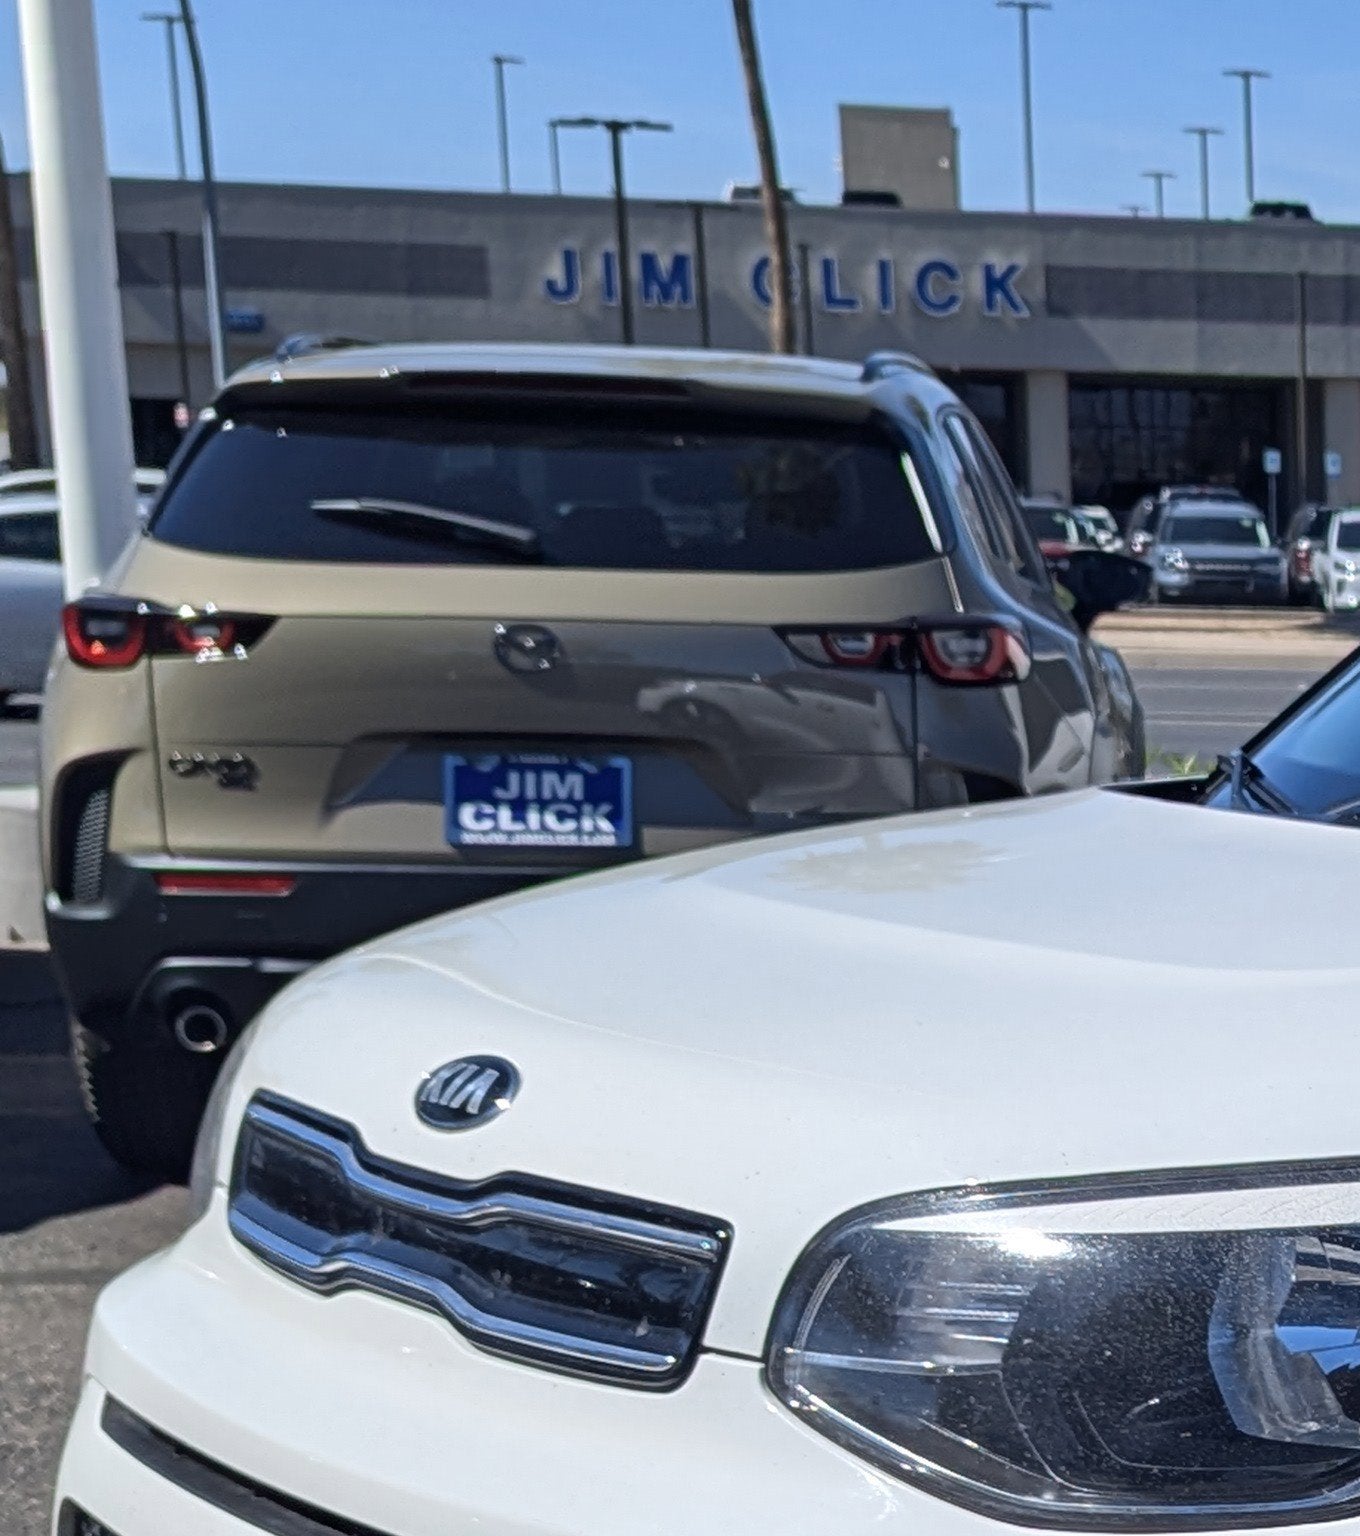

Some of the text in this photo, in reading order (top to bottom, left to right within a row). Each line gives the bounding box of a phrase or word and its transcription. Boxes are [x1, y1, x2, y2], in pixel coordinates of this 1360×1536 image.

[545, 249, 693, 306] JIM
[493, 769, 584, 800] JIM
[458, 801, 616, 833] CLICK
[420, 1062, 500, 1115] KIA
